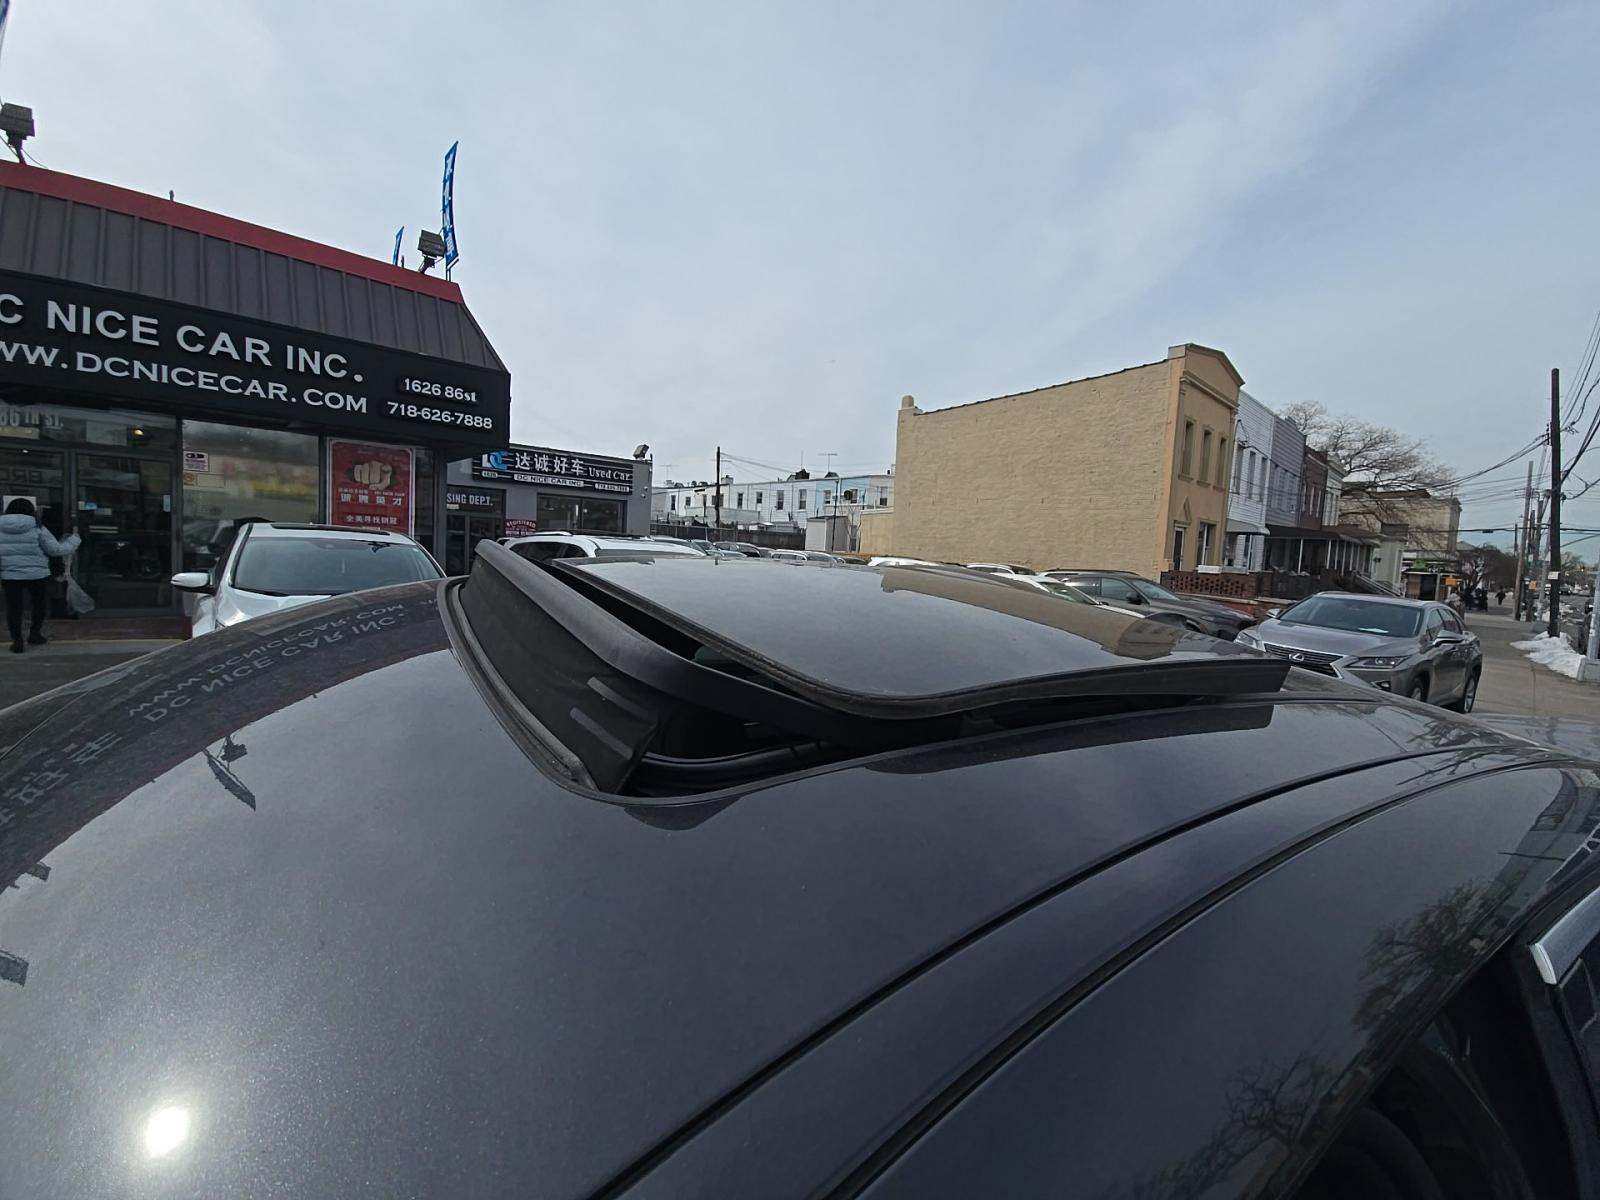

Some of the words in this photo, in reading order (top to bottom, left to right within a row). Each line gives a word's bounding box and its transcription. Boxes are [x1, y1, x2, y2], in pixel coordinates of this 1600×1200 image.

[47, 300, 160, 346] NICE
[176, 325, 272, 366] CAR
[287, 345, 364, 382] INC.
[405, 378, 441, 396] 1626
[445, 386, 478, 402] 86st
[387, 401, 493, 429] 718-626-7888
[515, 452, 584, 476] 达诚好车
[588, 467, 612, 479] Used
[613, 470, 631, 481] Car
[469, 495, 493, 506] DEPT.
